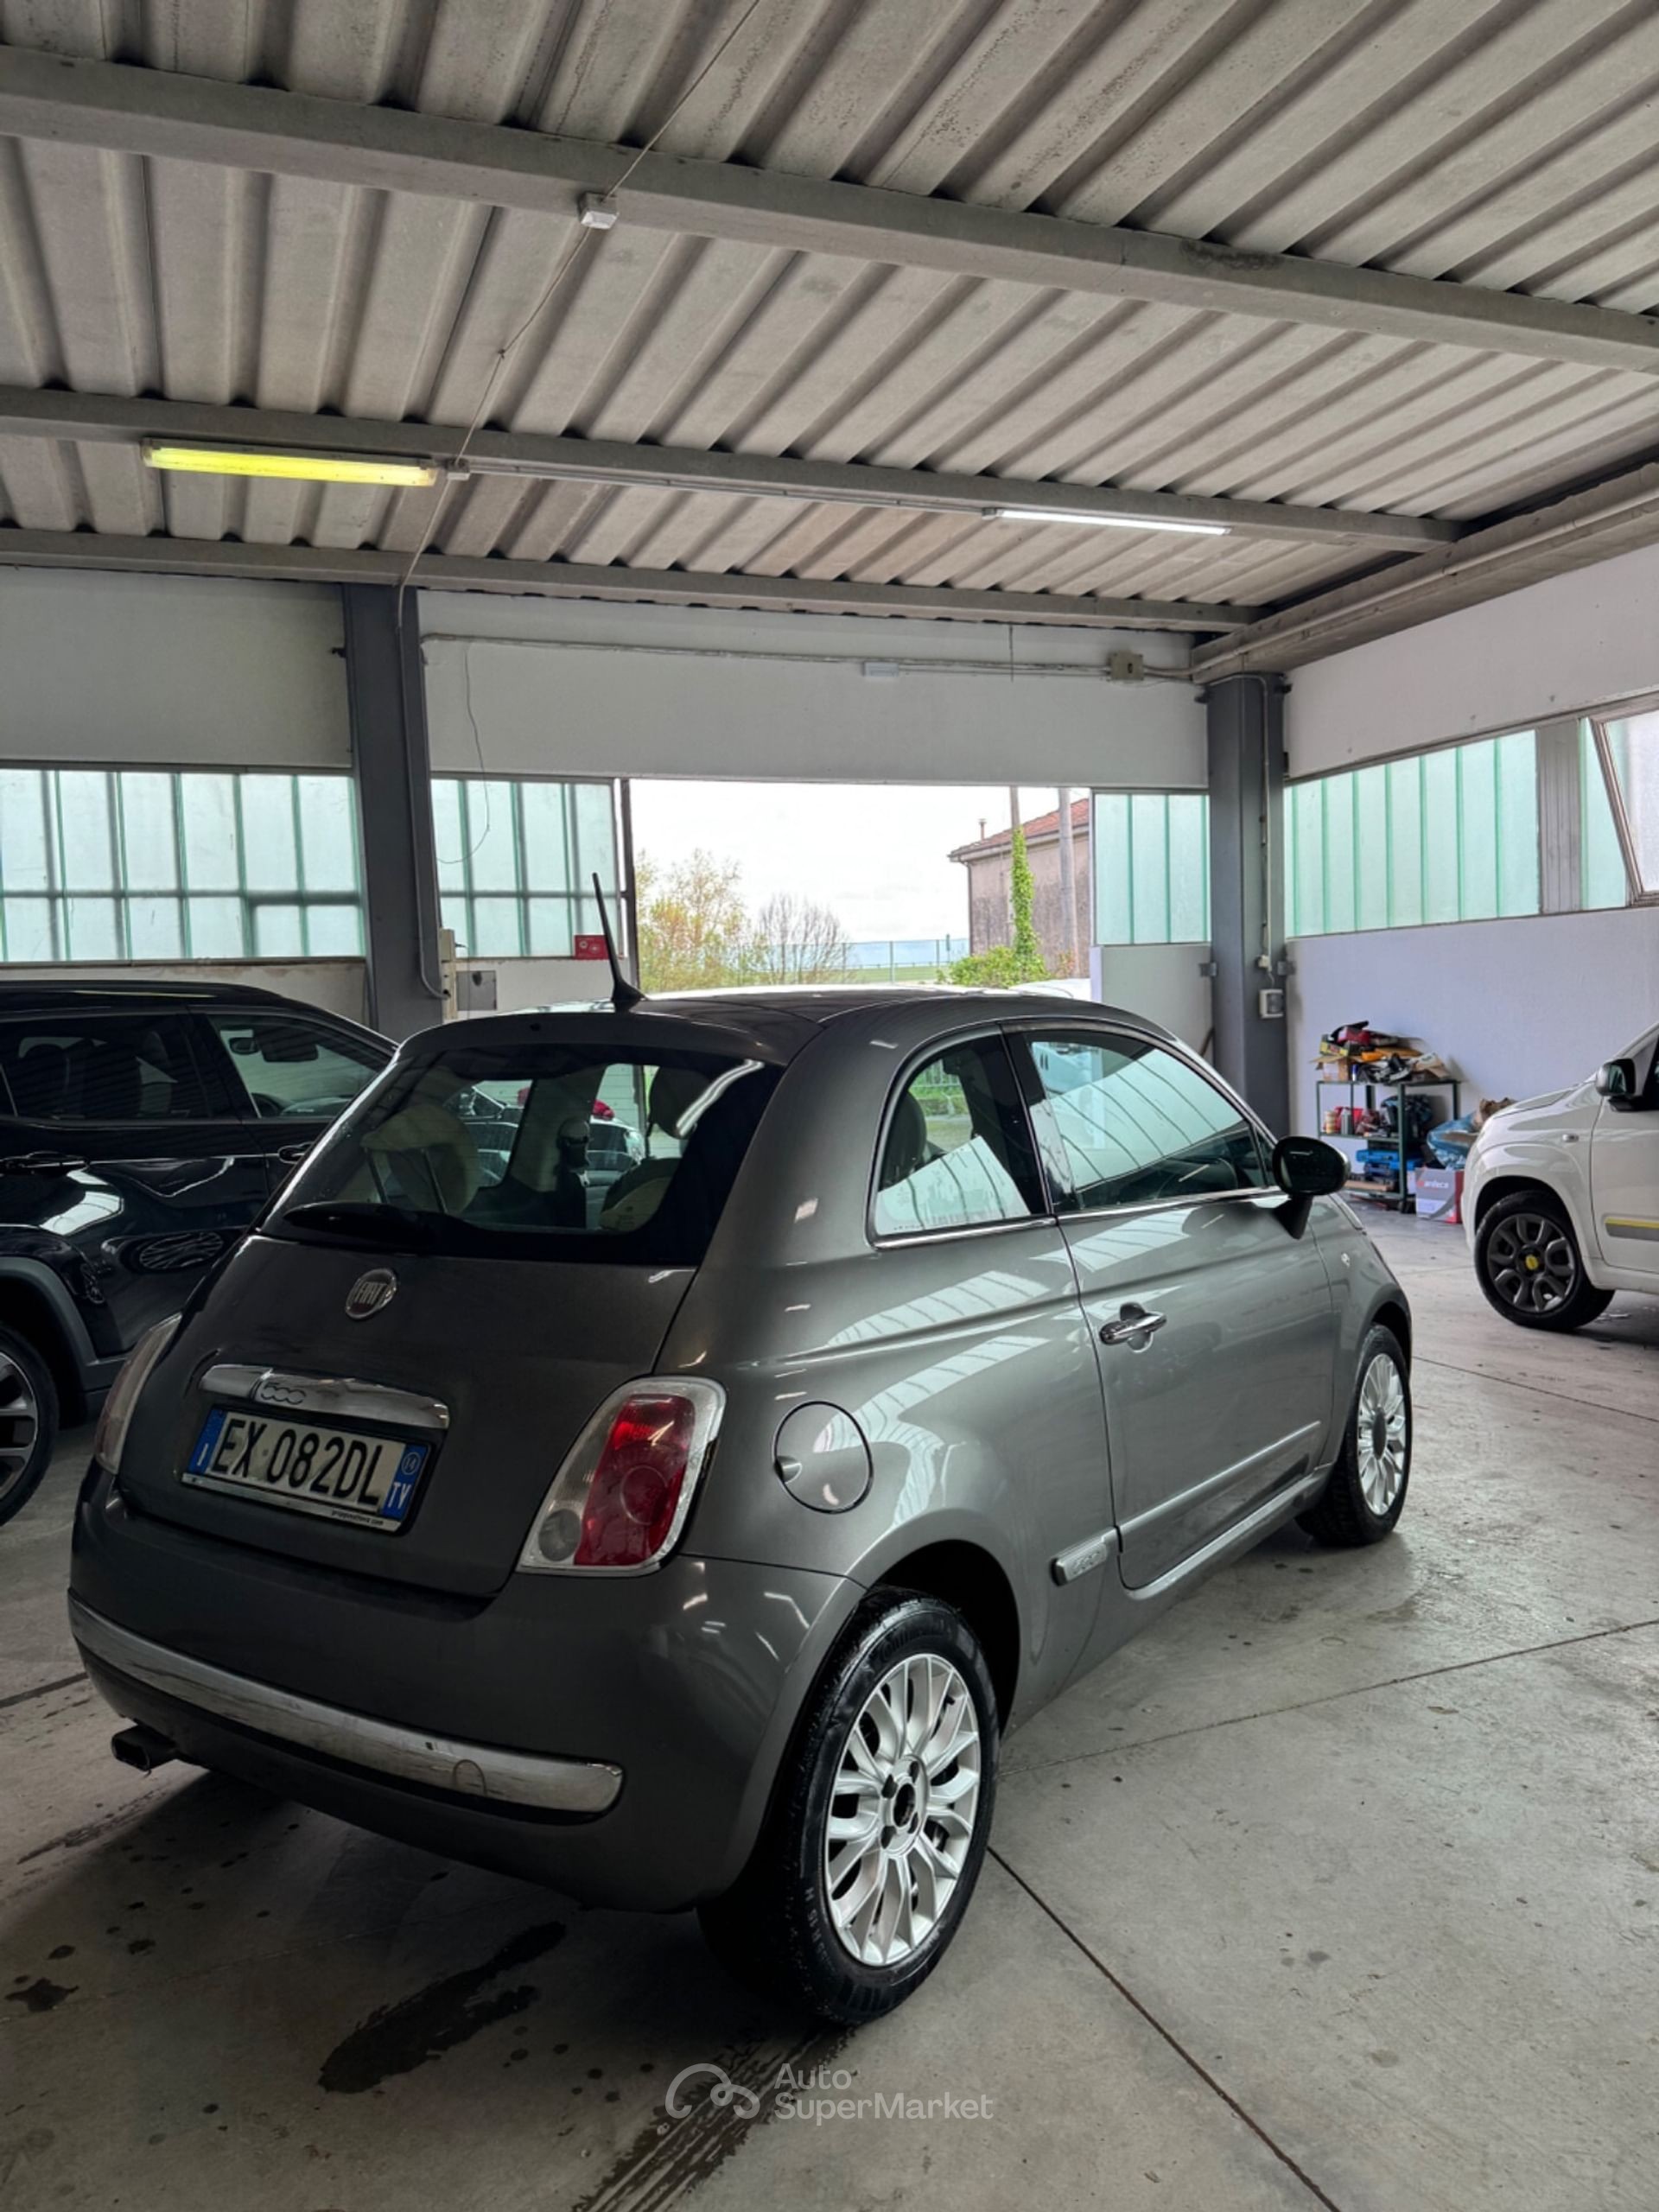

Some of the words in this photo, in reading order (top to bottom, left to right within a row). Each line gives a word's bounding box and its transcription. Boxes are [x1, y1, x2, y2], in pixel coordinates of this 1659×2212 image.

[353, 1281, 388, 1306] FIAT
[261, 1381, 306, 1405] 500
[197, 1443, 209, 1467] I
[211, 1418, 267, 1478] EX
[266, 1428, 383, 1505] 082DL
[387, 1481, 412, 1510] TV
